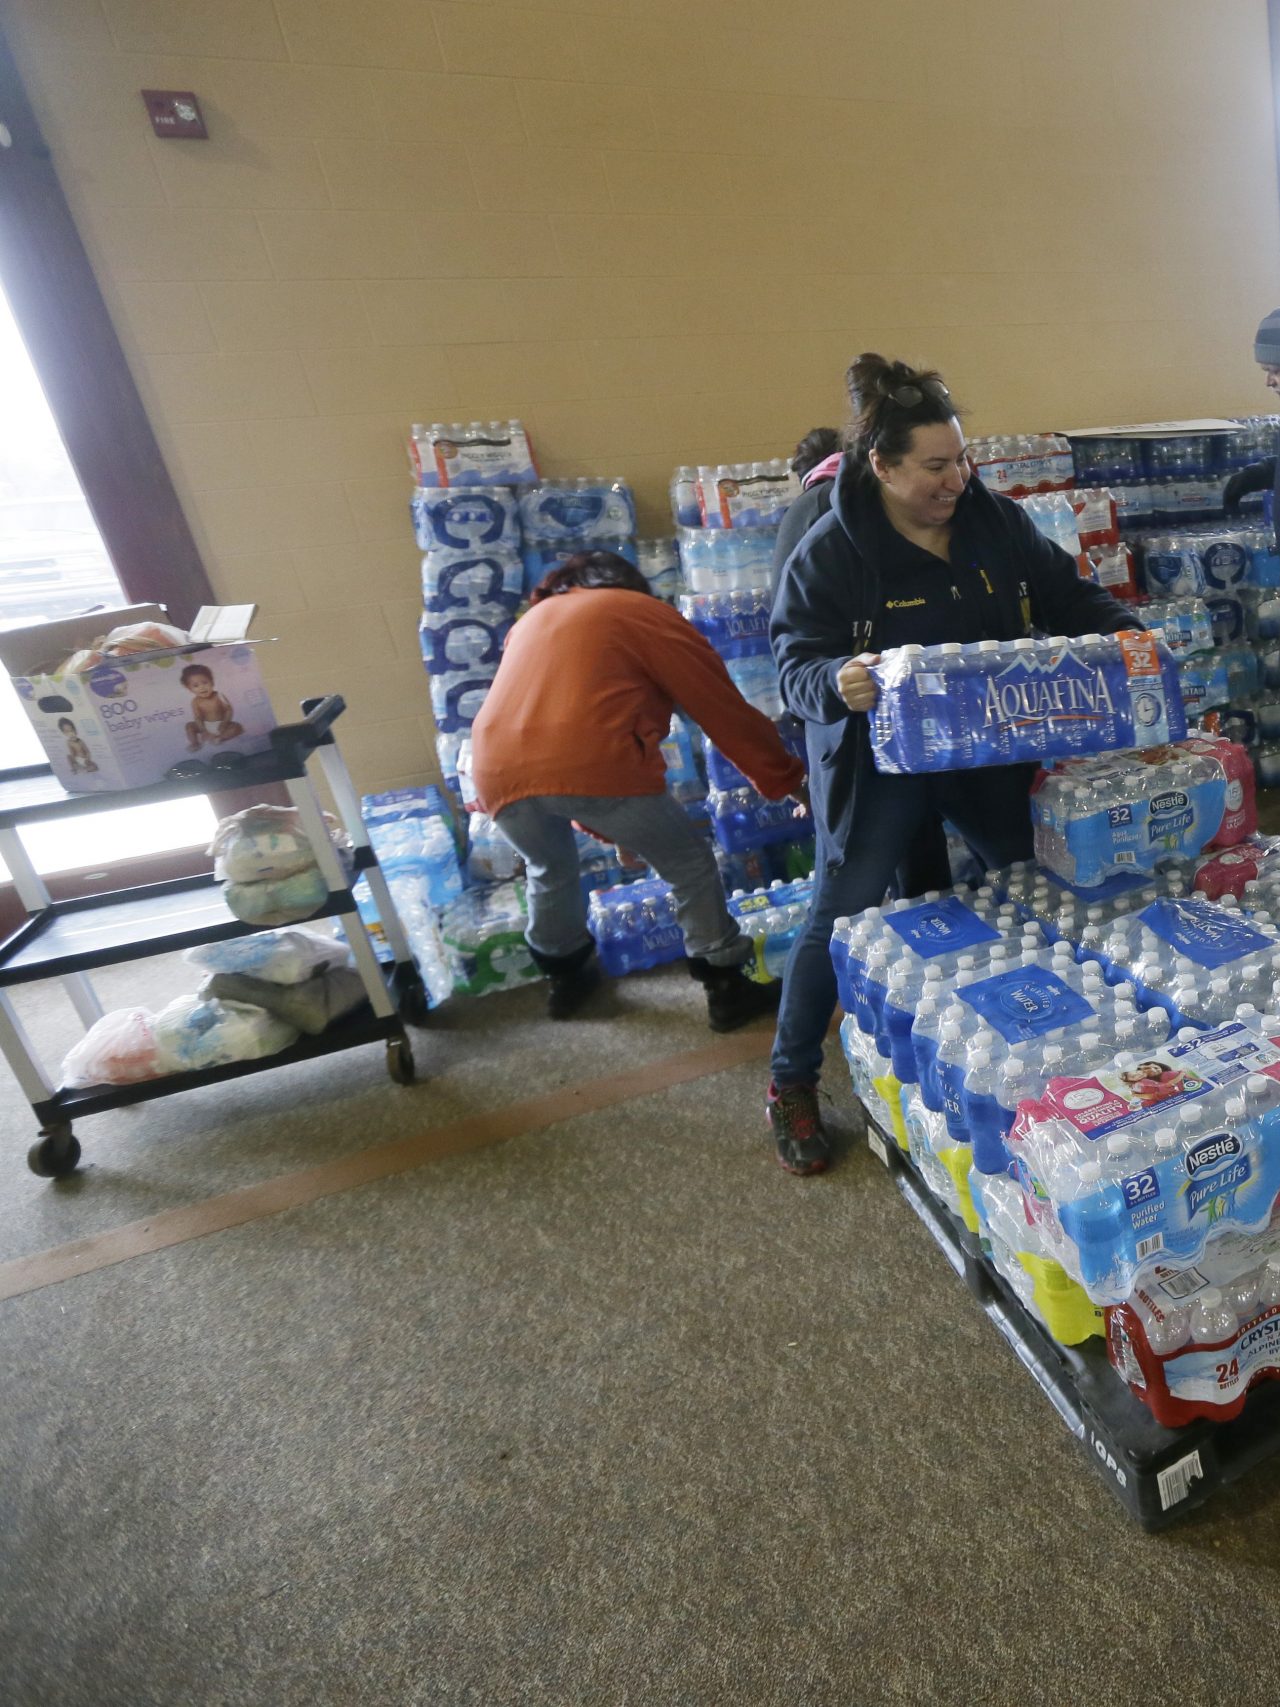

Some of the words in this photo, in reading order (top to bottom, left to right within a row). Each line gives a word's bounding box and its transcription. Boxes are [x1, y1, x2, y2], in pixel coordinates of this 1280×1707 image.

[894, 597, 926, 607] Columbia
[1130, 651, 1153, 669] 32
[983, 666, 1116, 728] AQUAFINA
[100, 699, 137, 719] 800
[105, 715, 143, 733] baby
[144, 707, 185, 723] wipes
[1111, 807, 1130, 823] 32
[1151, 821, 1172, 836] Pure
[1174, 814, 1192, 829] Life
[1010, 988, 1038, 1013] WATER
[1181, 1038, 1202, 1052] 32
[1080, 1102, 1124, 1124] QUALITY
[1189, 1138, 1235, 1171] Nestlé
[1126, 1175, 1156, 1200] 32
[1190, 1181, 1216, 1210] Pure
[1220, 1164, 1245, 1188] Life
[1131, 1201, 1165, 1221] Purified
[1132, 1213, 1158, 1230] Water
[1138, 1290, 1165, 1323] BOTTLES
[1248, 1335, 1280, 1359] ALPINE
[1215, 1358, 1240, 1384] 24
[1219, 1377, 1240, 1390] BOTTLES
